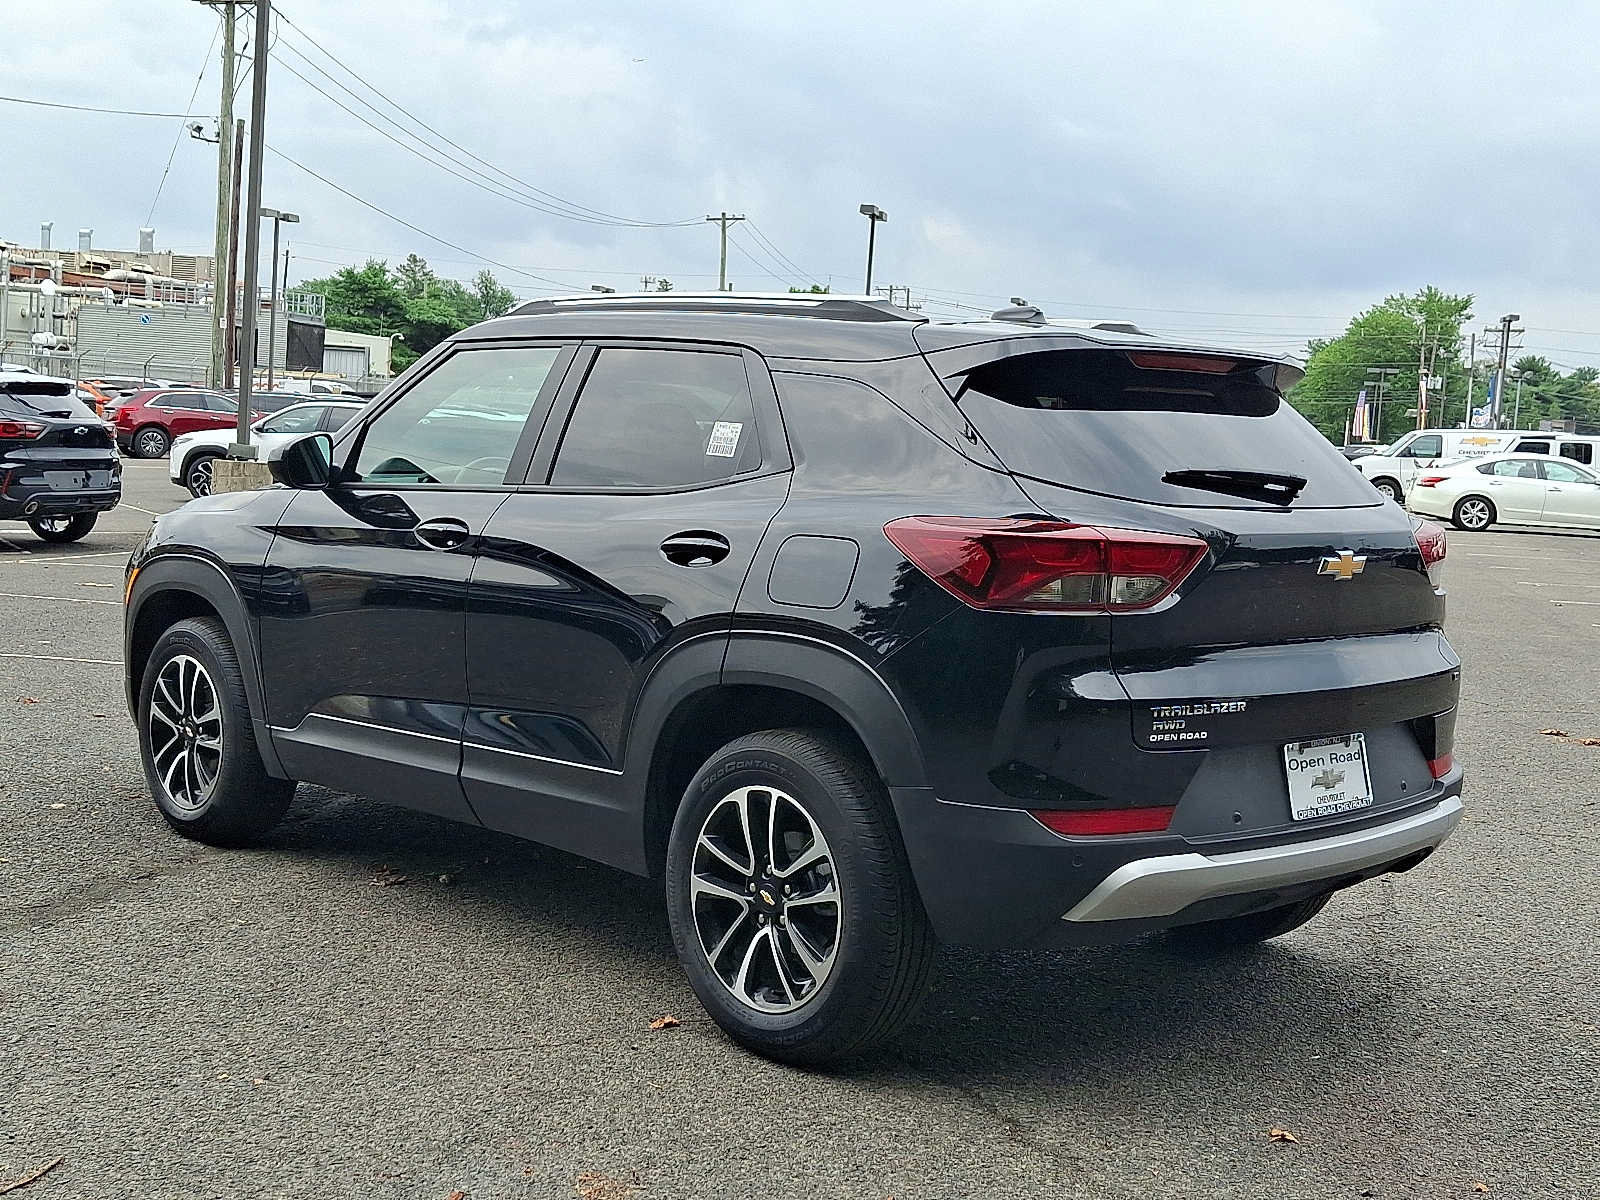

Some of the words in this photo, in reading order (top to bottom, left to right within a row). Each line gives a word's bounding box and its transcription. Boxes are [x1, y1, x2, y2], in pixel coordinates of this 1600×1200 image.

[1150, 701, 1247, 718] TRAILBLAZER
[1152, 719, 1186, 731] AWD
[1149, 733, 1178, 742] OPEN
[1179, 731, 1208, 740] ROAD
[1288, 757, 1325, 773] Open
[1329, 749, 1361, 765] Road
[1298, 809, 1317, 819] OPEN
[1319, 805, 1337, 816] ROAD
[1337, 798, 1372, 813] CHEVROLET
